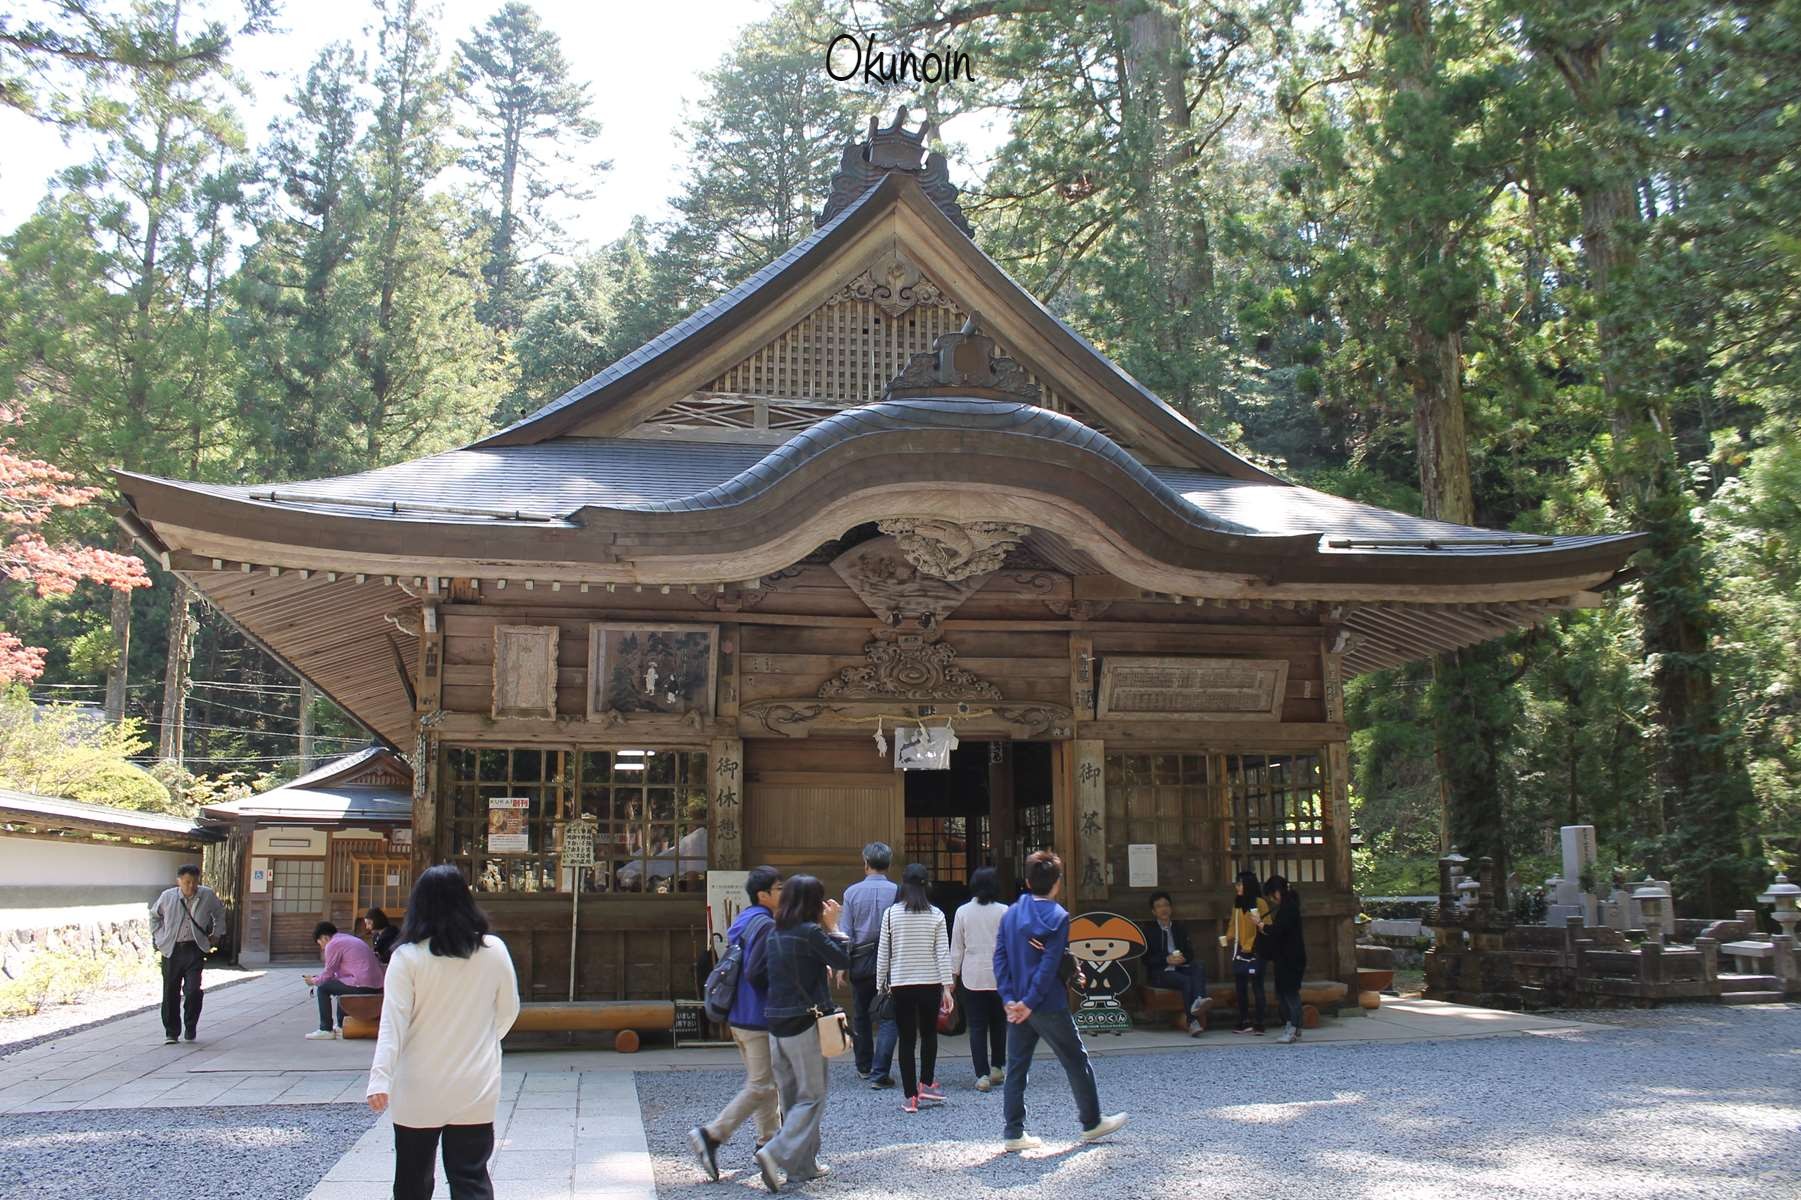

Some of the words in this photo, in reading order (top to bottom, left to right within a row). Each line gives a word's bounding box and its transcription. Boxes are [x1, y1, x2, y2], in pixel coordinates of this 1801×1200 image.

[1076, 1013, 1127, 1024] こうやくん
